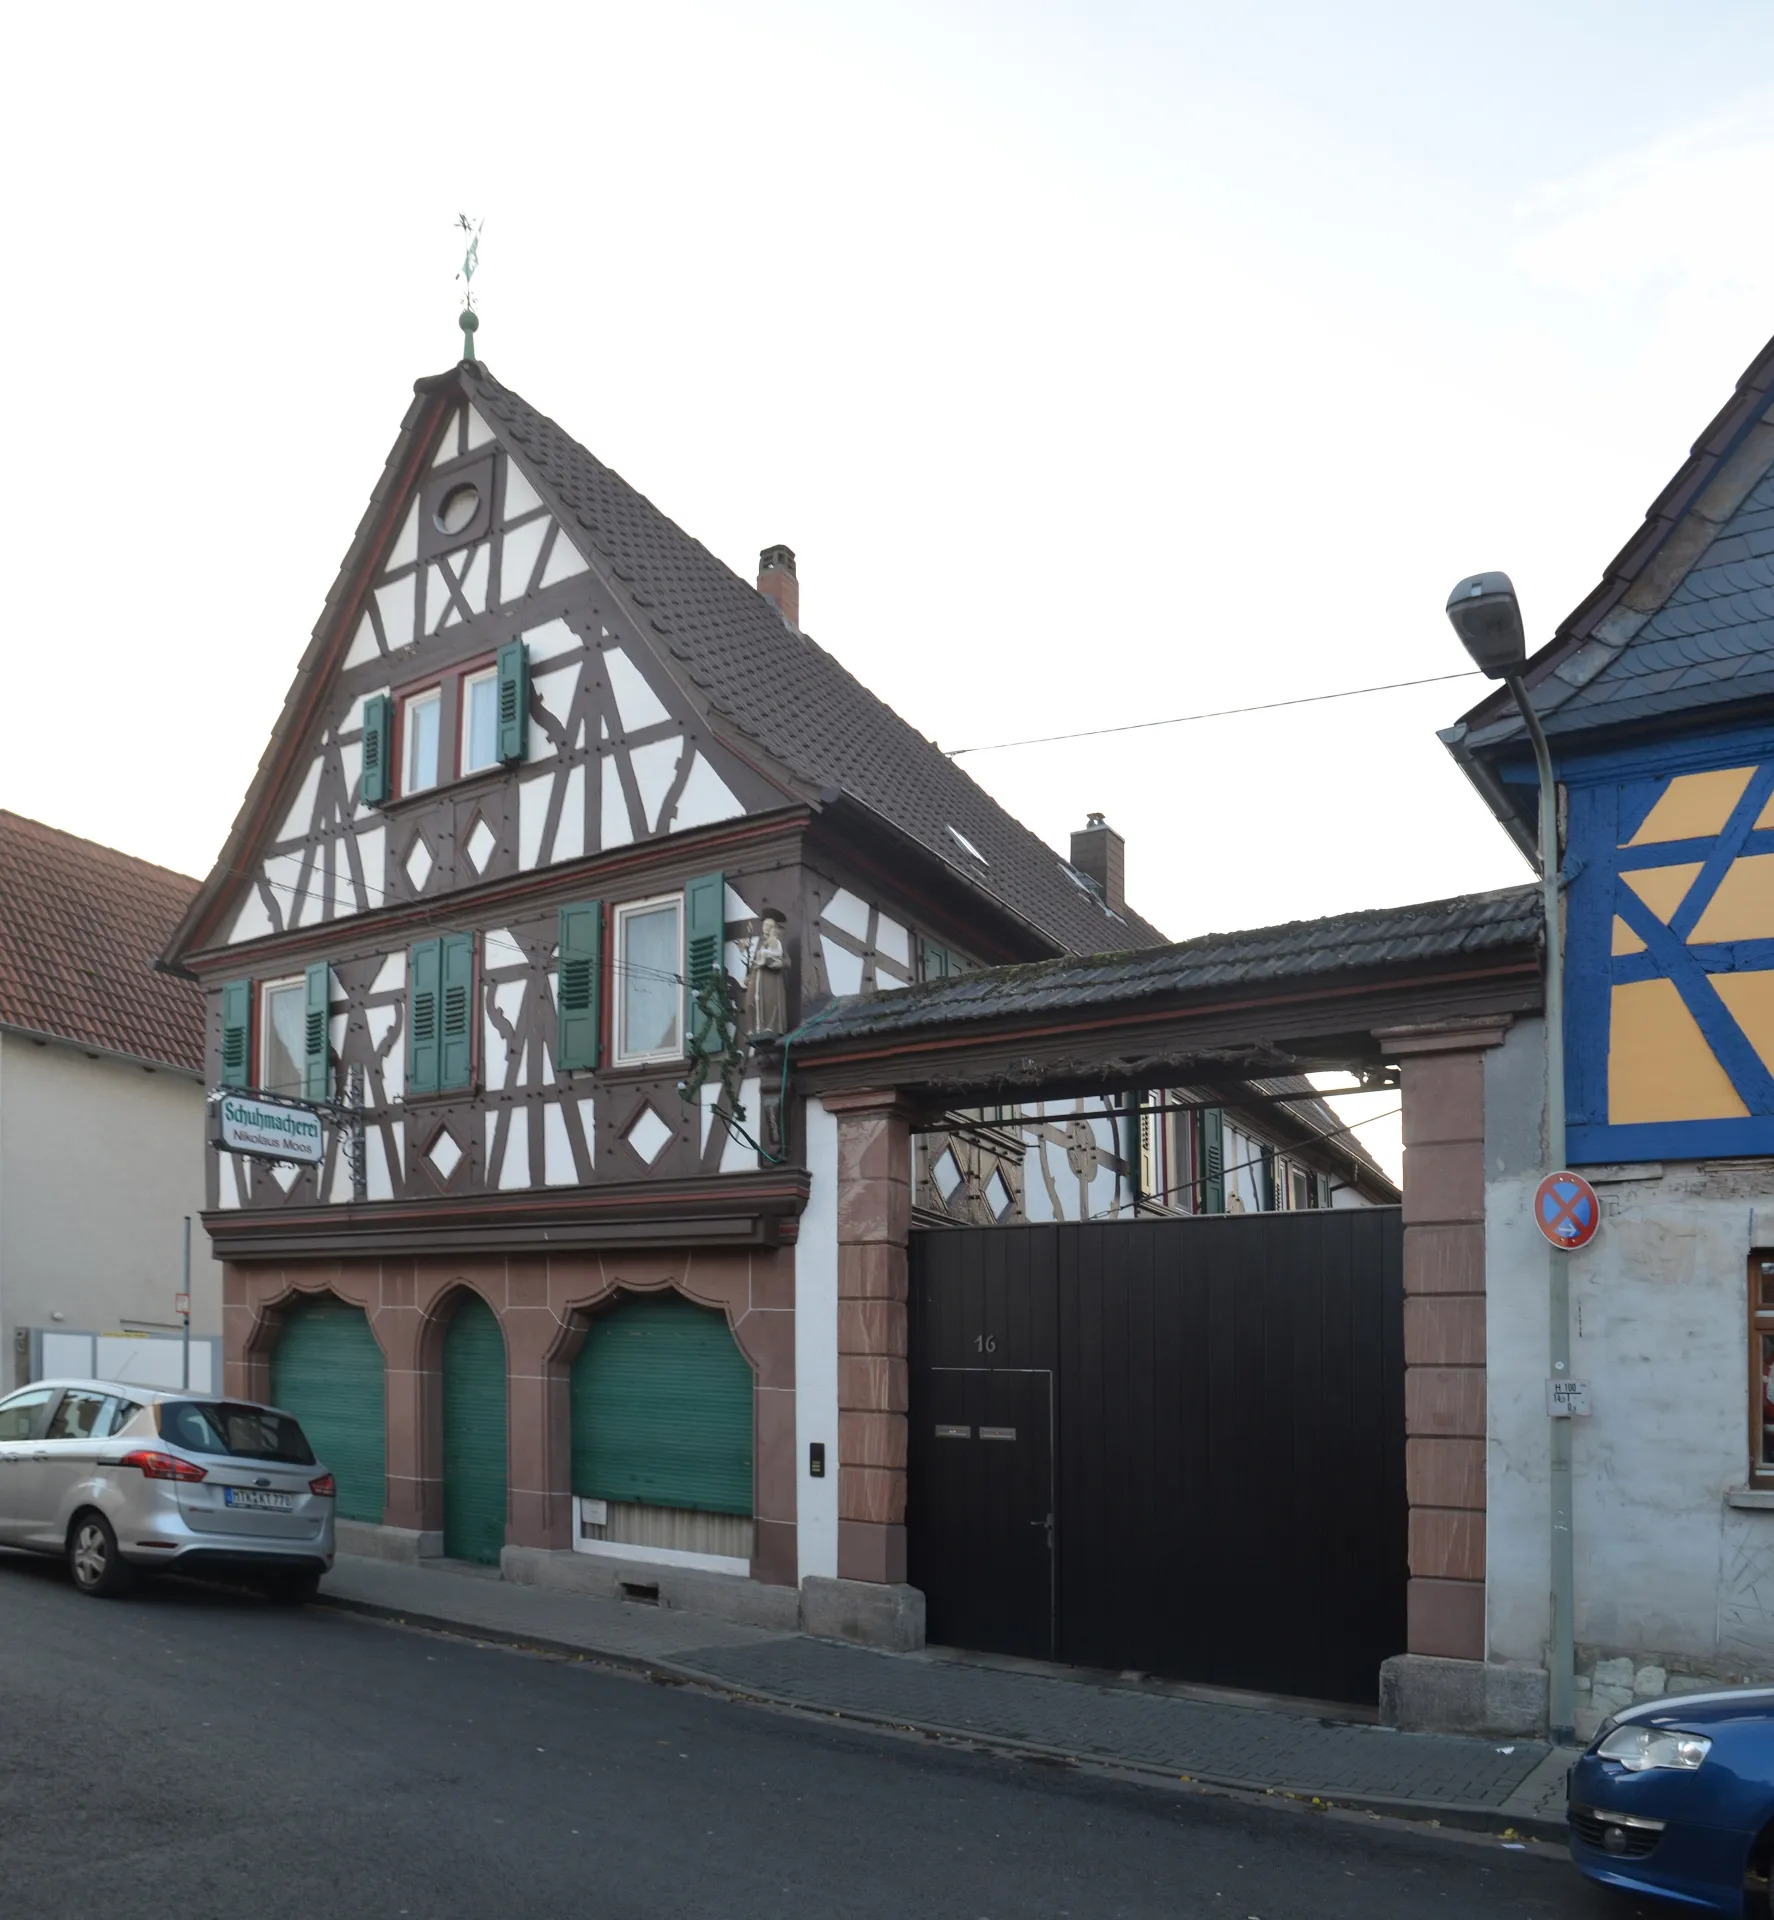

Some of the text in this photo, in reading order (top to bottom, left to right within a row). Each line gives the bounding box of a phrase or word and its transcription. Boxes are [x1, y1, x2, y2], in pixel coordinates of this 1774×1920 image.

[225, 1101, 319, 1138] Schuhmacherei
[233, 1129, 313, 1154] Nikolaus Moos
[974, 1334, 996, 1353] 16
[1554, 1383, 1561, 1392] H
[1564, 1383, 1577, 1392] 100
